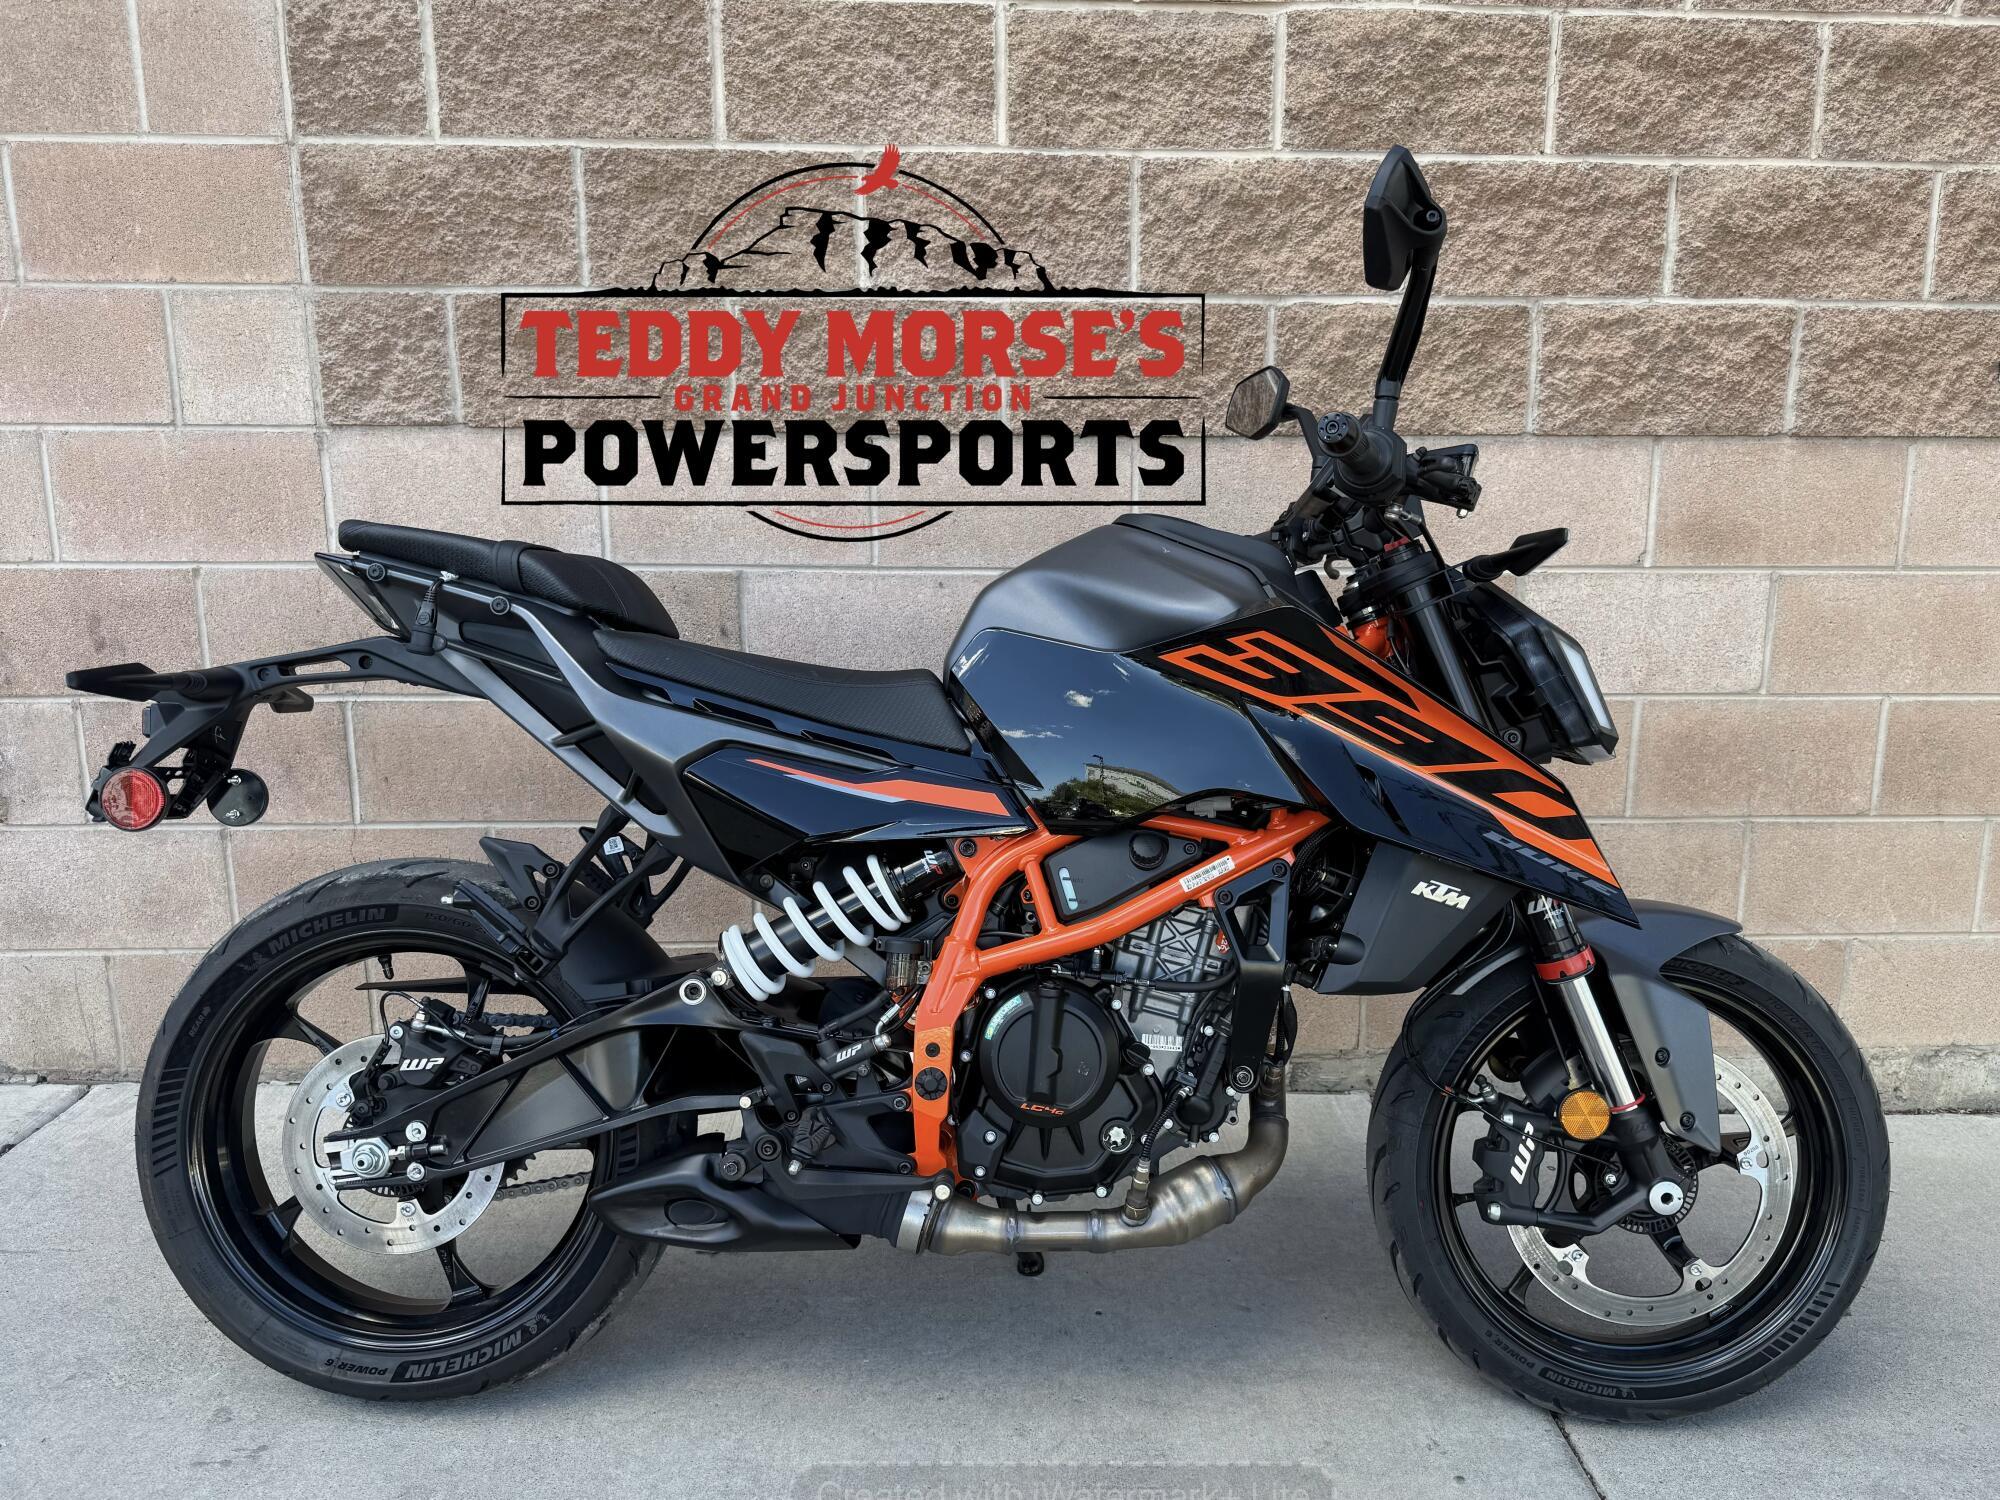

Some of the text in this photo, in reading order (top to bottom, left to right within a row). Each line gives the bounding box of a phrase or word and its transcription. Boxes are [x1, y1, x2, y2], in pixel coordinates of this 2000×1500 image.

[1482, 830, 1618, 897] DUKE
[1410, 879, 1471, 910] KTM
[270, 907, 387, 955] MICHELIN
[400, 1057, 445, 1071] WP
[836, 1043, 862, 1063] WP
[1510, 1121, 1536, 1185] WP
[403, 1328, 523, 1380] MICHELIN
[1494, 1335, 1536, 1369] POWER
[337, 1360, 389, 1377] POWER
[1545, 1369, 1618, 1398] MICHELIN
